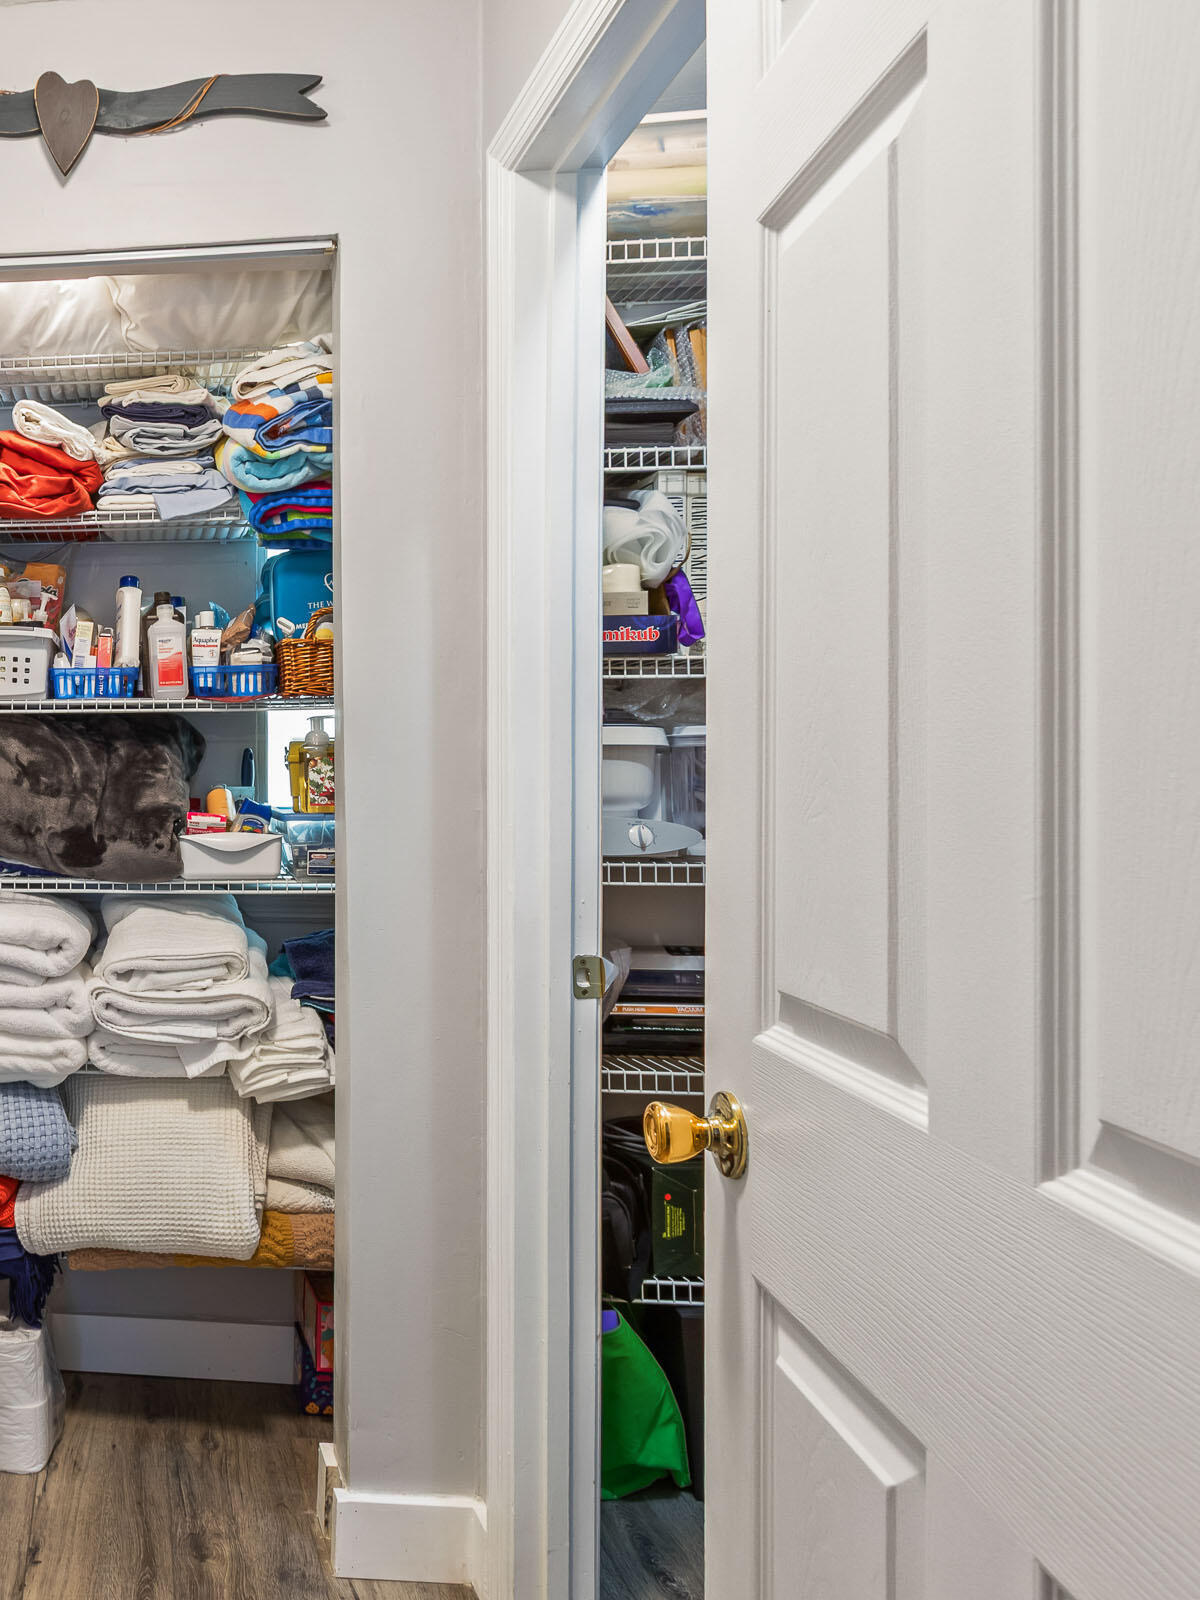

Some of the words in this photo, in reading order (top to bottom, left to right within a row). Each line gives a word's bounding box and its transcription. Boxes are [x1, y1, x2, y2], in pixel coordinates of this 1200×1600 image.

[307, 600, 324, 610] THE
[603, 626, 660, 642] mikub
[192, 636, 218, 645] Aquaphor
